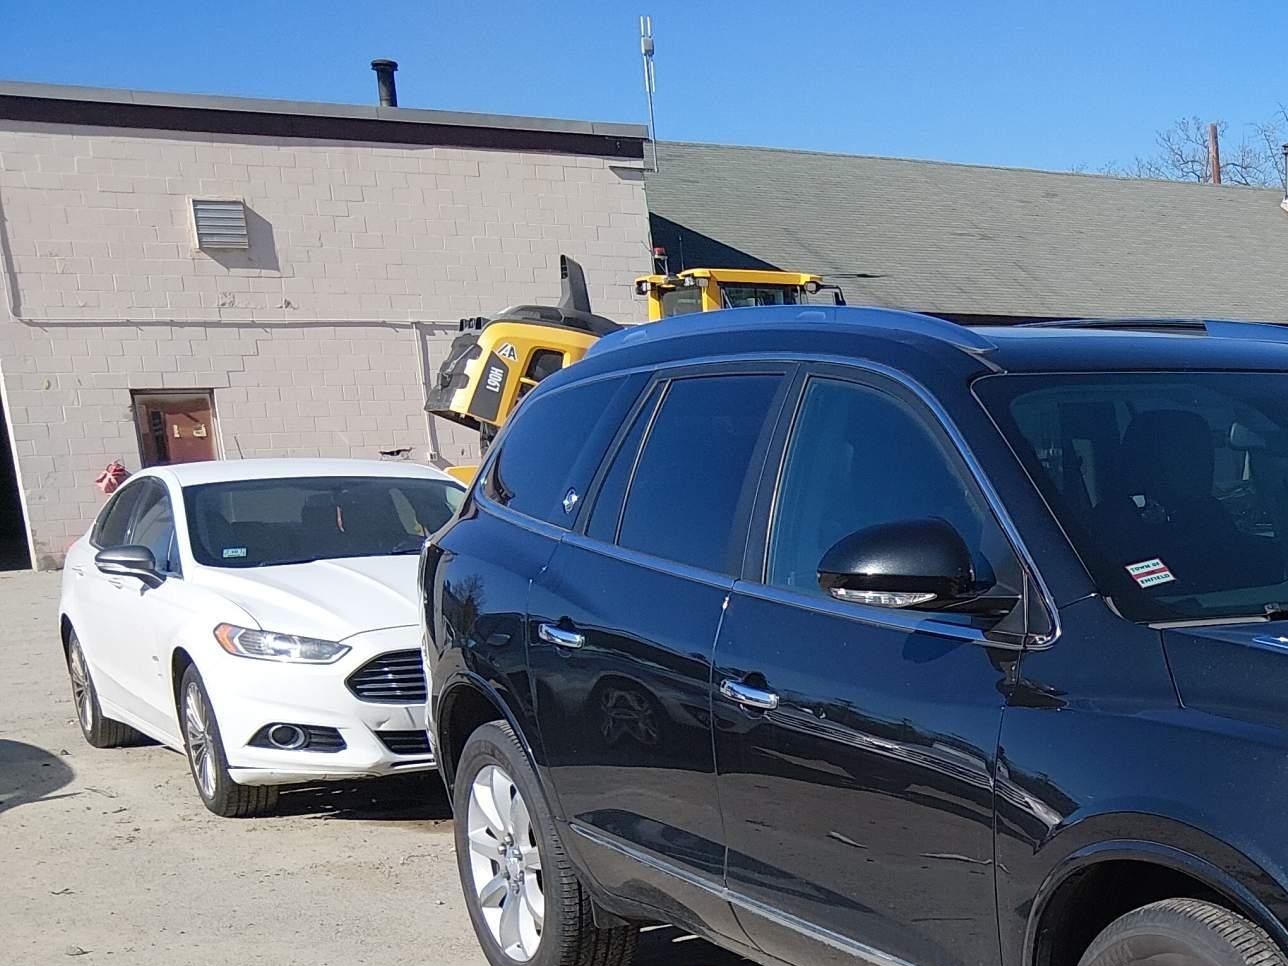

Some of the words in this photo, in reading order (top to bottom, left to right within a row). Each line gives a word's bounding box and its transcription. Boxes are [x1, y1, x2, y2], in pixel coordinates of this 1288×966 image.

[486, 366, 504, 393] L90H
[1130, 564, 1151, 573] TOWN
[1140, 573, 1170, 585] ENFIELD
